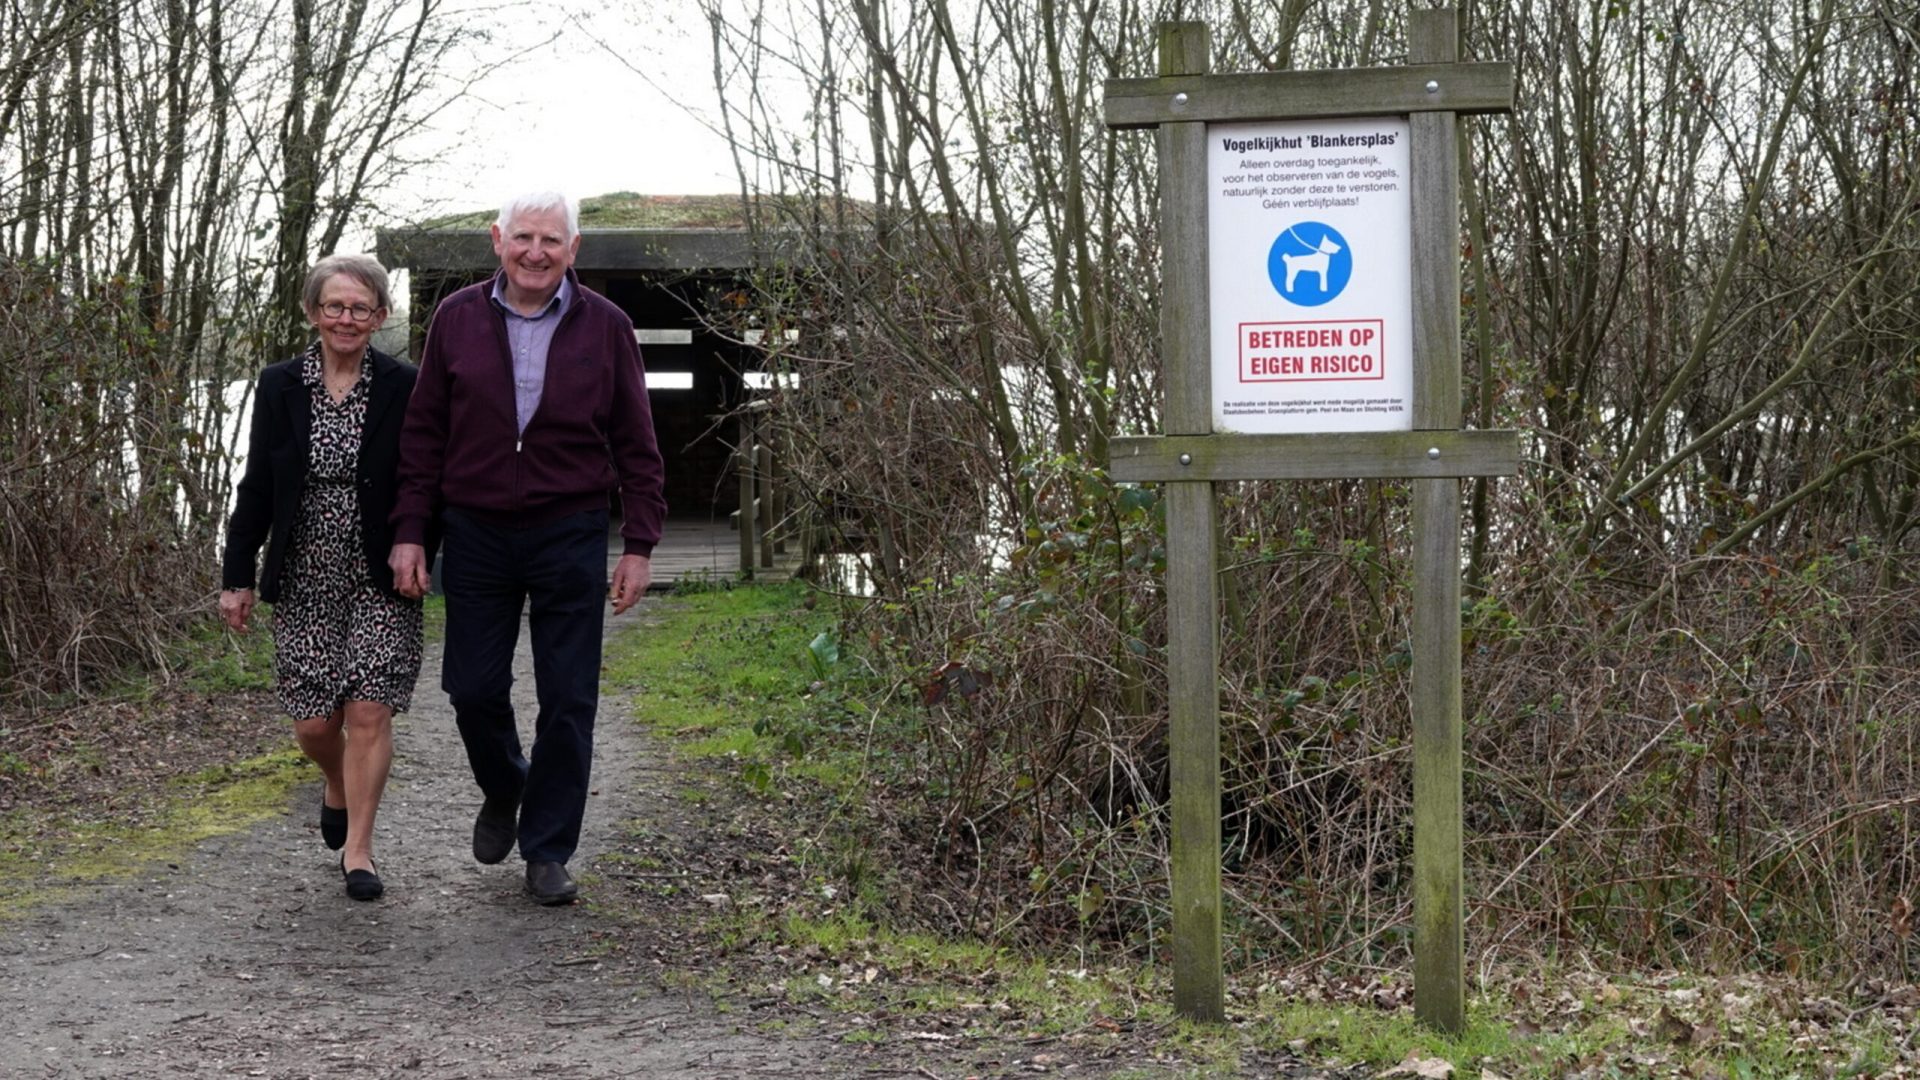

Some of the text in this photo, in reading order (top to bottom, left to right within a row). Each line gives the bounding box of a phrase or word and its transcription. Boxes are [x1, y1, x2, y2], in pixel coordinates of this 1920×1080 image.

[1223, 136, 1302, 153] Vogelkijkhut
[1240, 156, 1382, 170] Alleen overdag toegankelijk,
[1222, 168, 1399, 183] voor het observeren van de vogels,
[1223, 182, 1399, 197] natuurlijk zonder deze te verstoren.
[1262, 198, 1359, 209] Géén verblijfplaats!
[1250, 328, 1374, 348] BETREDEN OP
[1251, 355, 1372, 375] EIGEN RISICO
